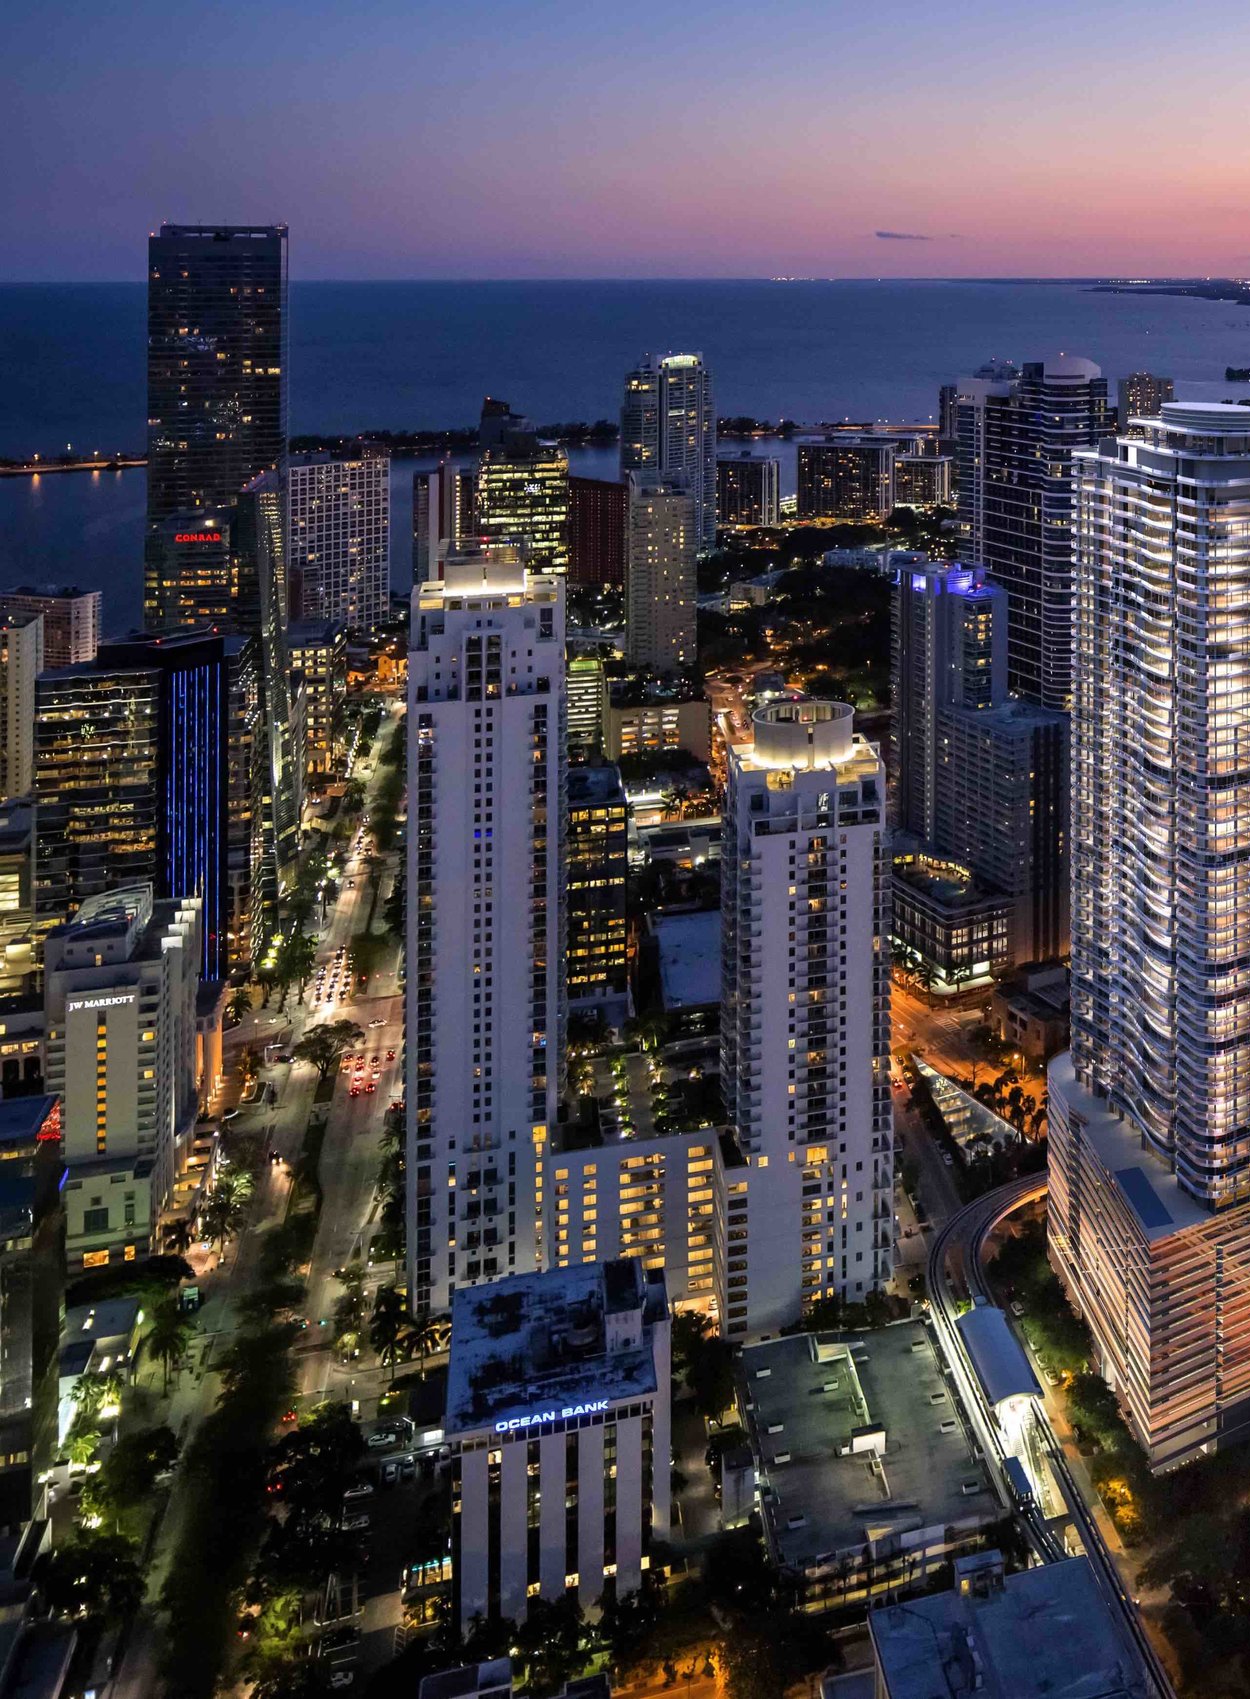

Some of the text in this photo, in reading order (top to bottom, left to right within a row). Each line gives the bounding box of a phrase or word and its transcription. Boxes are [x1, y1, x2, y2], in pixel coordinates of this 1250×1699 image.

[175, 533, 221, 542] CONRAD
[68, 995, 135, 1012] JW MARRIOTT
[495, 1400, 609, 1432] OCEAN BANK
